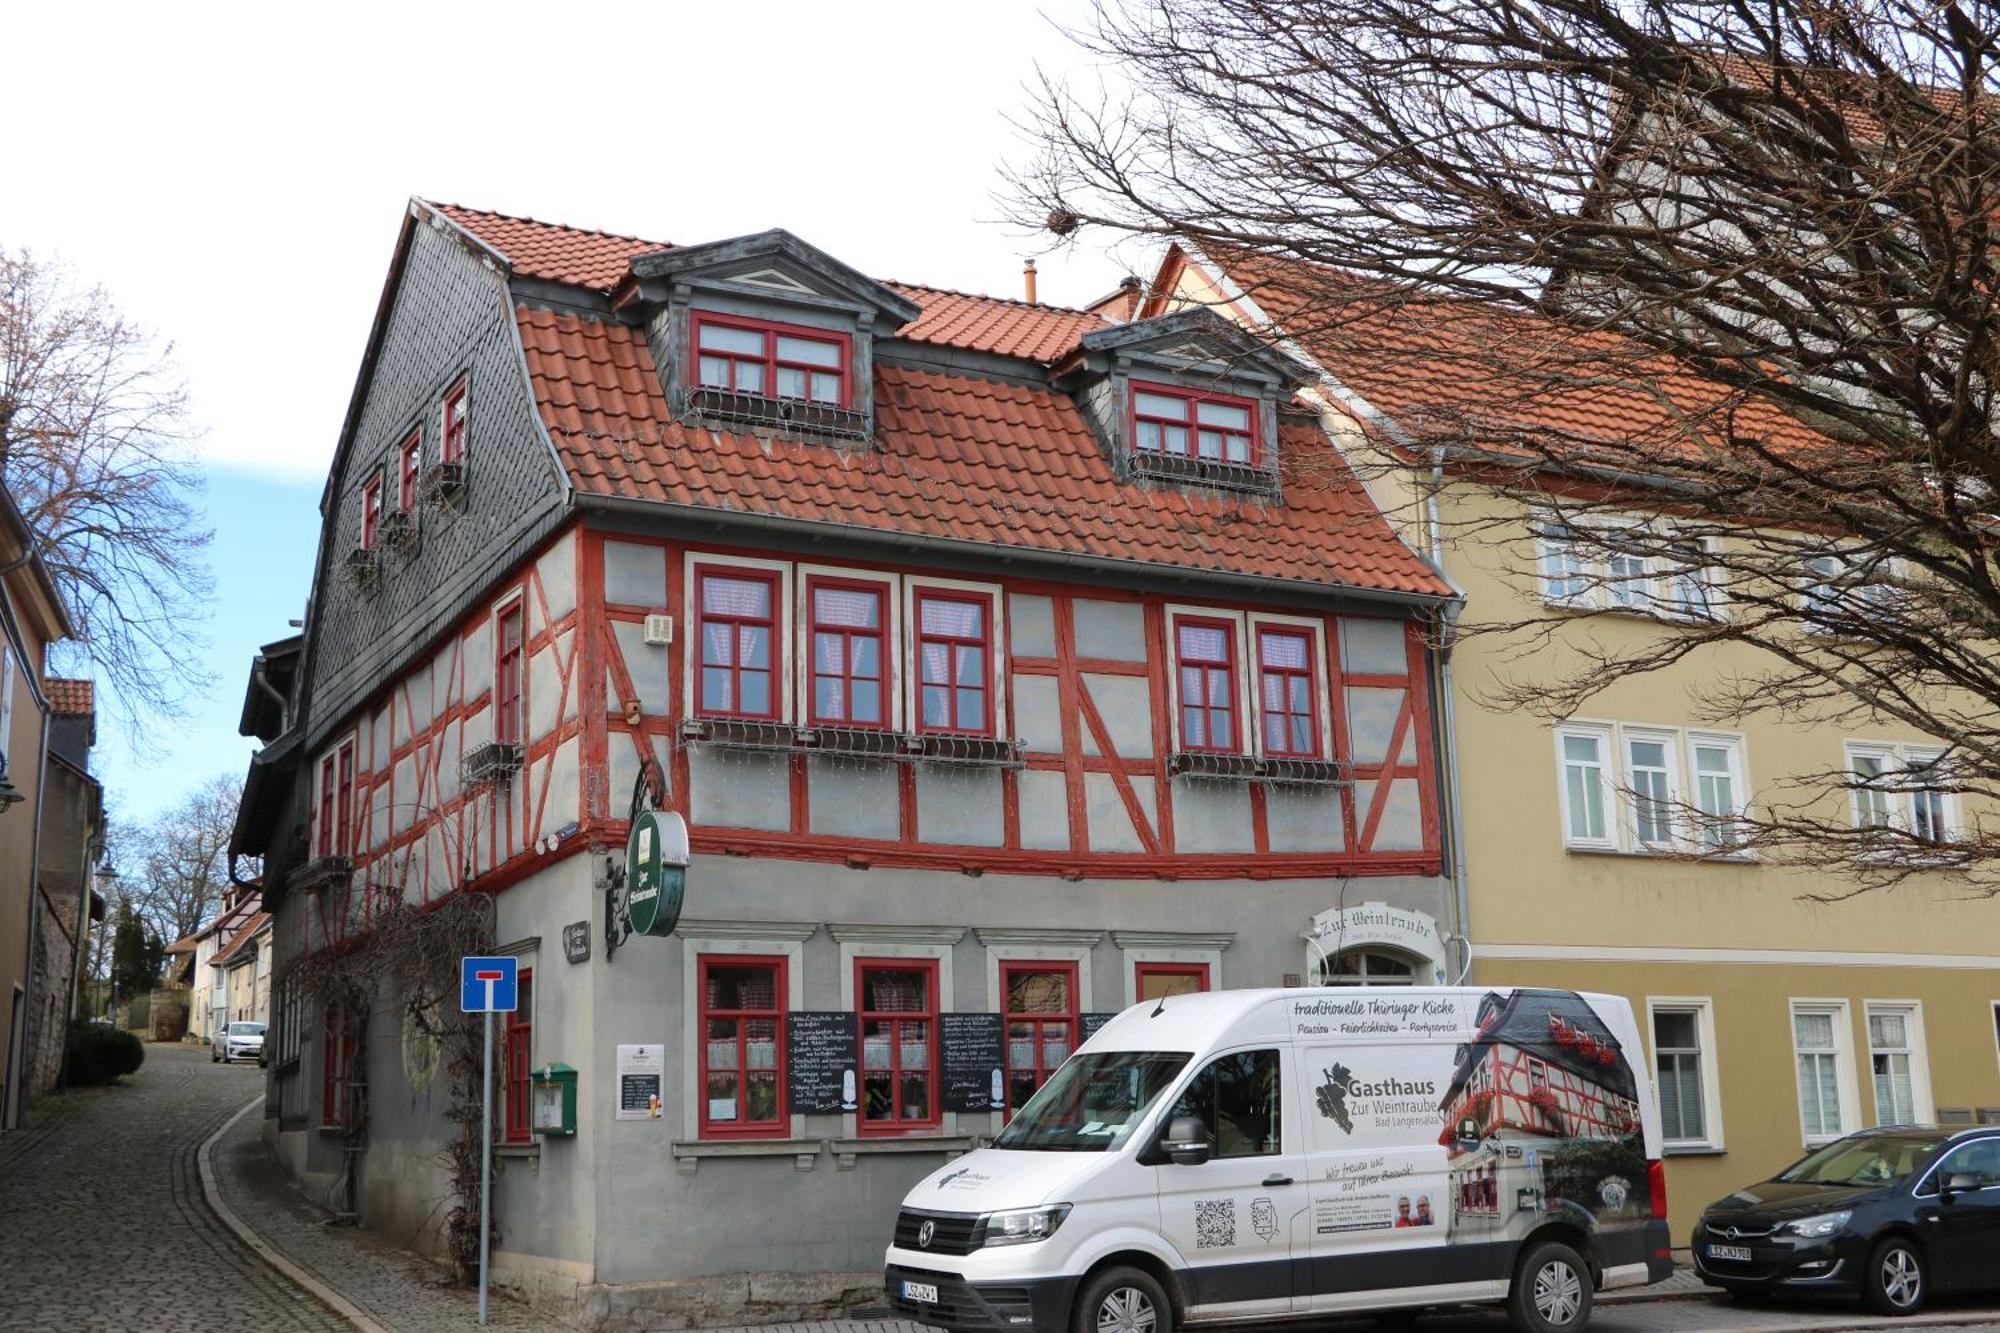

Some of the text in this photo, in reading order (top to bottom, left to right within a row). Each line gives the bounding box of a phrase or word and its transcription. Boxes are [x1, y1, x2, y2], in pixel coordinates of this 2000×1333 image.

[1320, 918, 1348, 937] Zur
[1352, 911, 1431, 938] Weintraube
[1294, 998, 1455, 1022] traditionelle Thüringer Küche
[1297, 1023, 1329, 1034] Pension
[1340, 1021, 1399, 1034] Feierlichkeiten
[1410, 1021, 1458, 1038] Partyservice
[1349, 1078, 1435, 1098] Gasthaus
[1351, 1099, 1438, 1115] Zur Weintraube
[1375, 1115, 1440, 1129] Bad Langensalza
